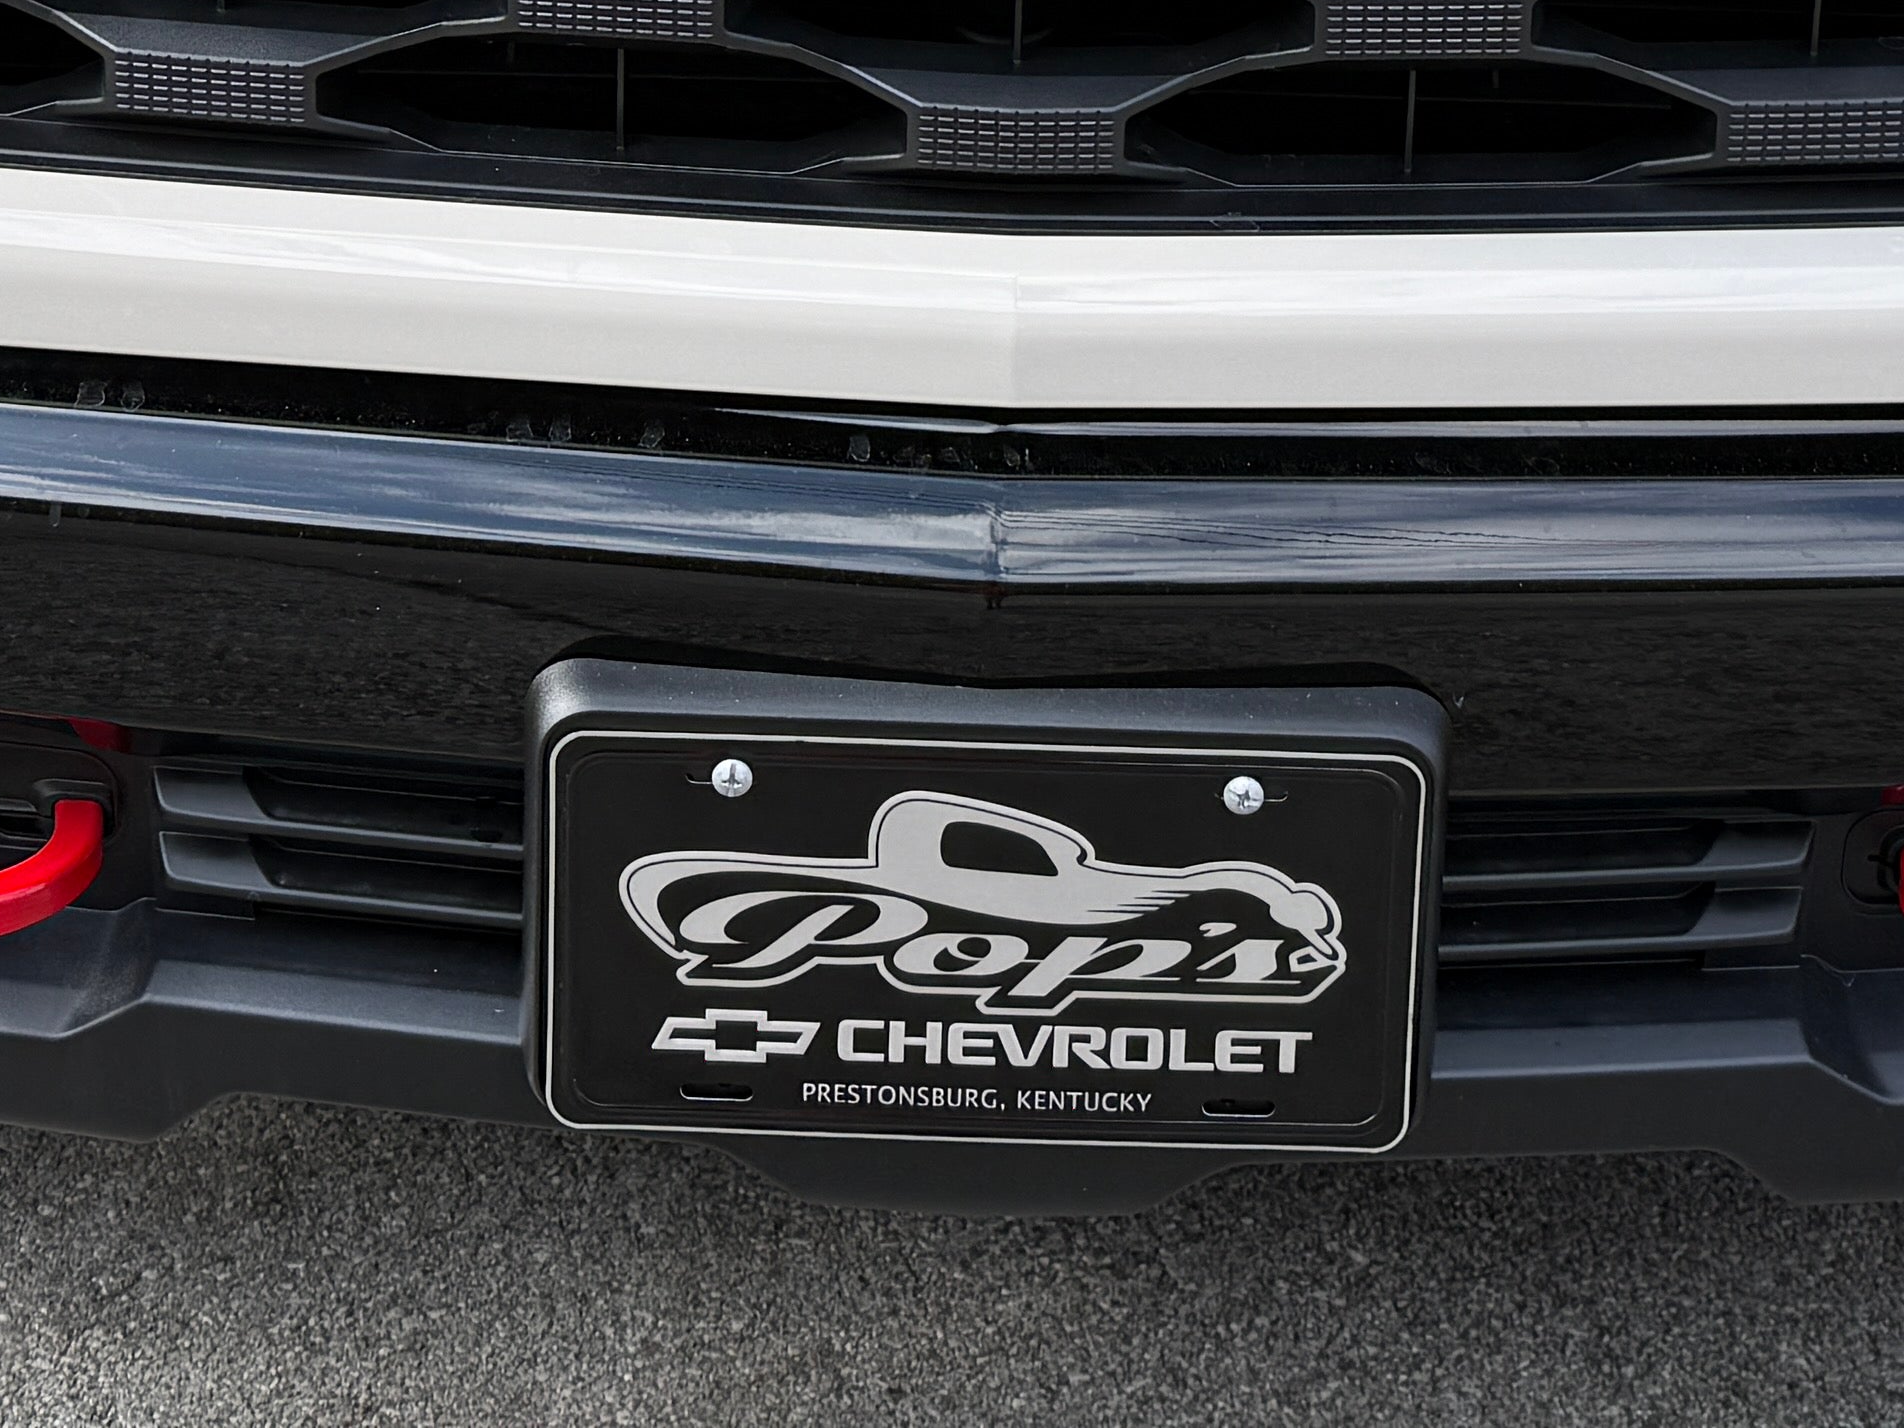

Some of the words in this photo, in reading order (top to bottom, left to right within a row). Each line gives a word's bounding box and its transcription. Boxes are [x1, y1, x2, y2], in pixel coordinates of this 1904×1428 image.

[679, 890, 1302, 997] Pop's
[836, 1020, 1314, 1074] CHEVROLET
[801, 1082, 1006, 1112] PRESTONSBURG,
[1016, 1089, 1152, 1113] KENTUCKY
